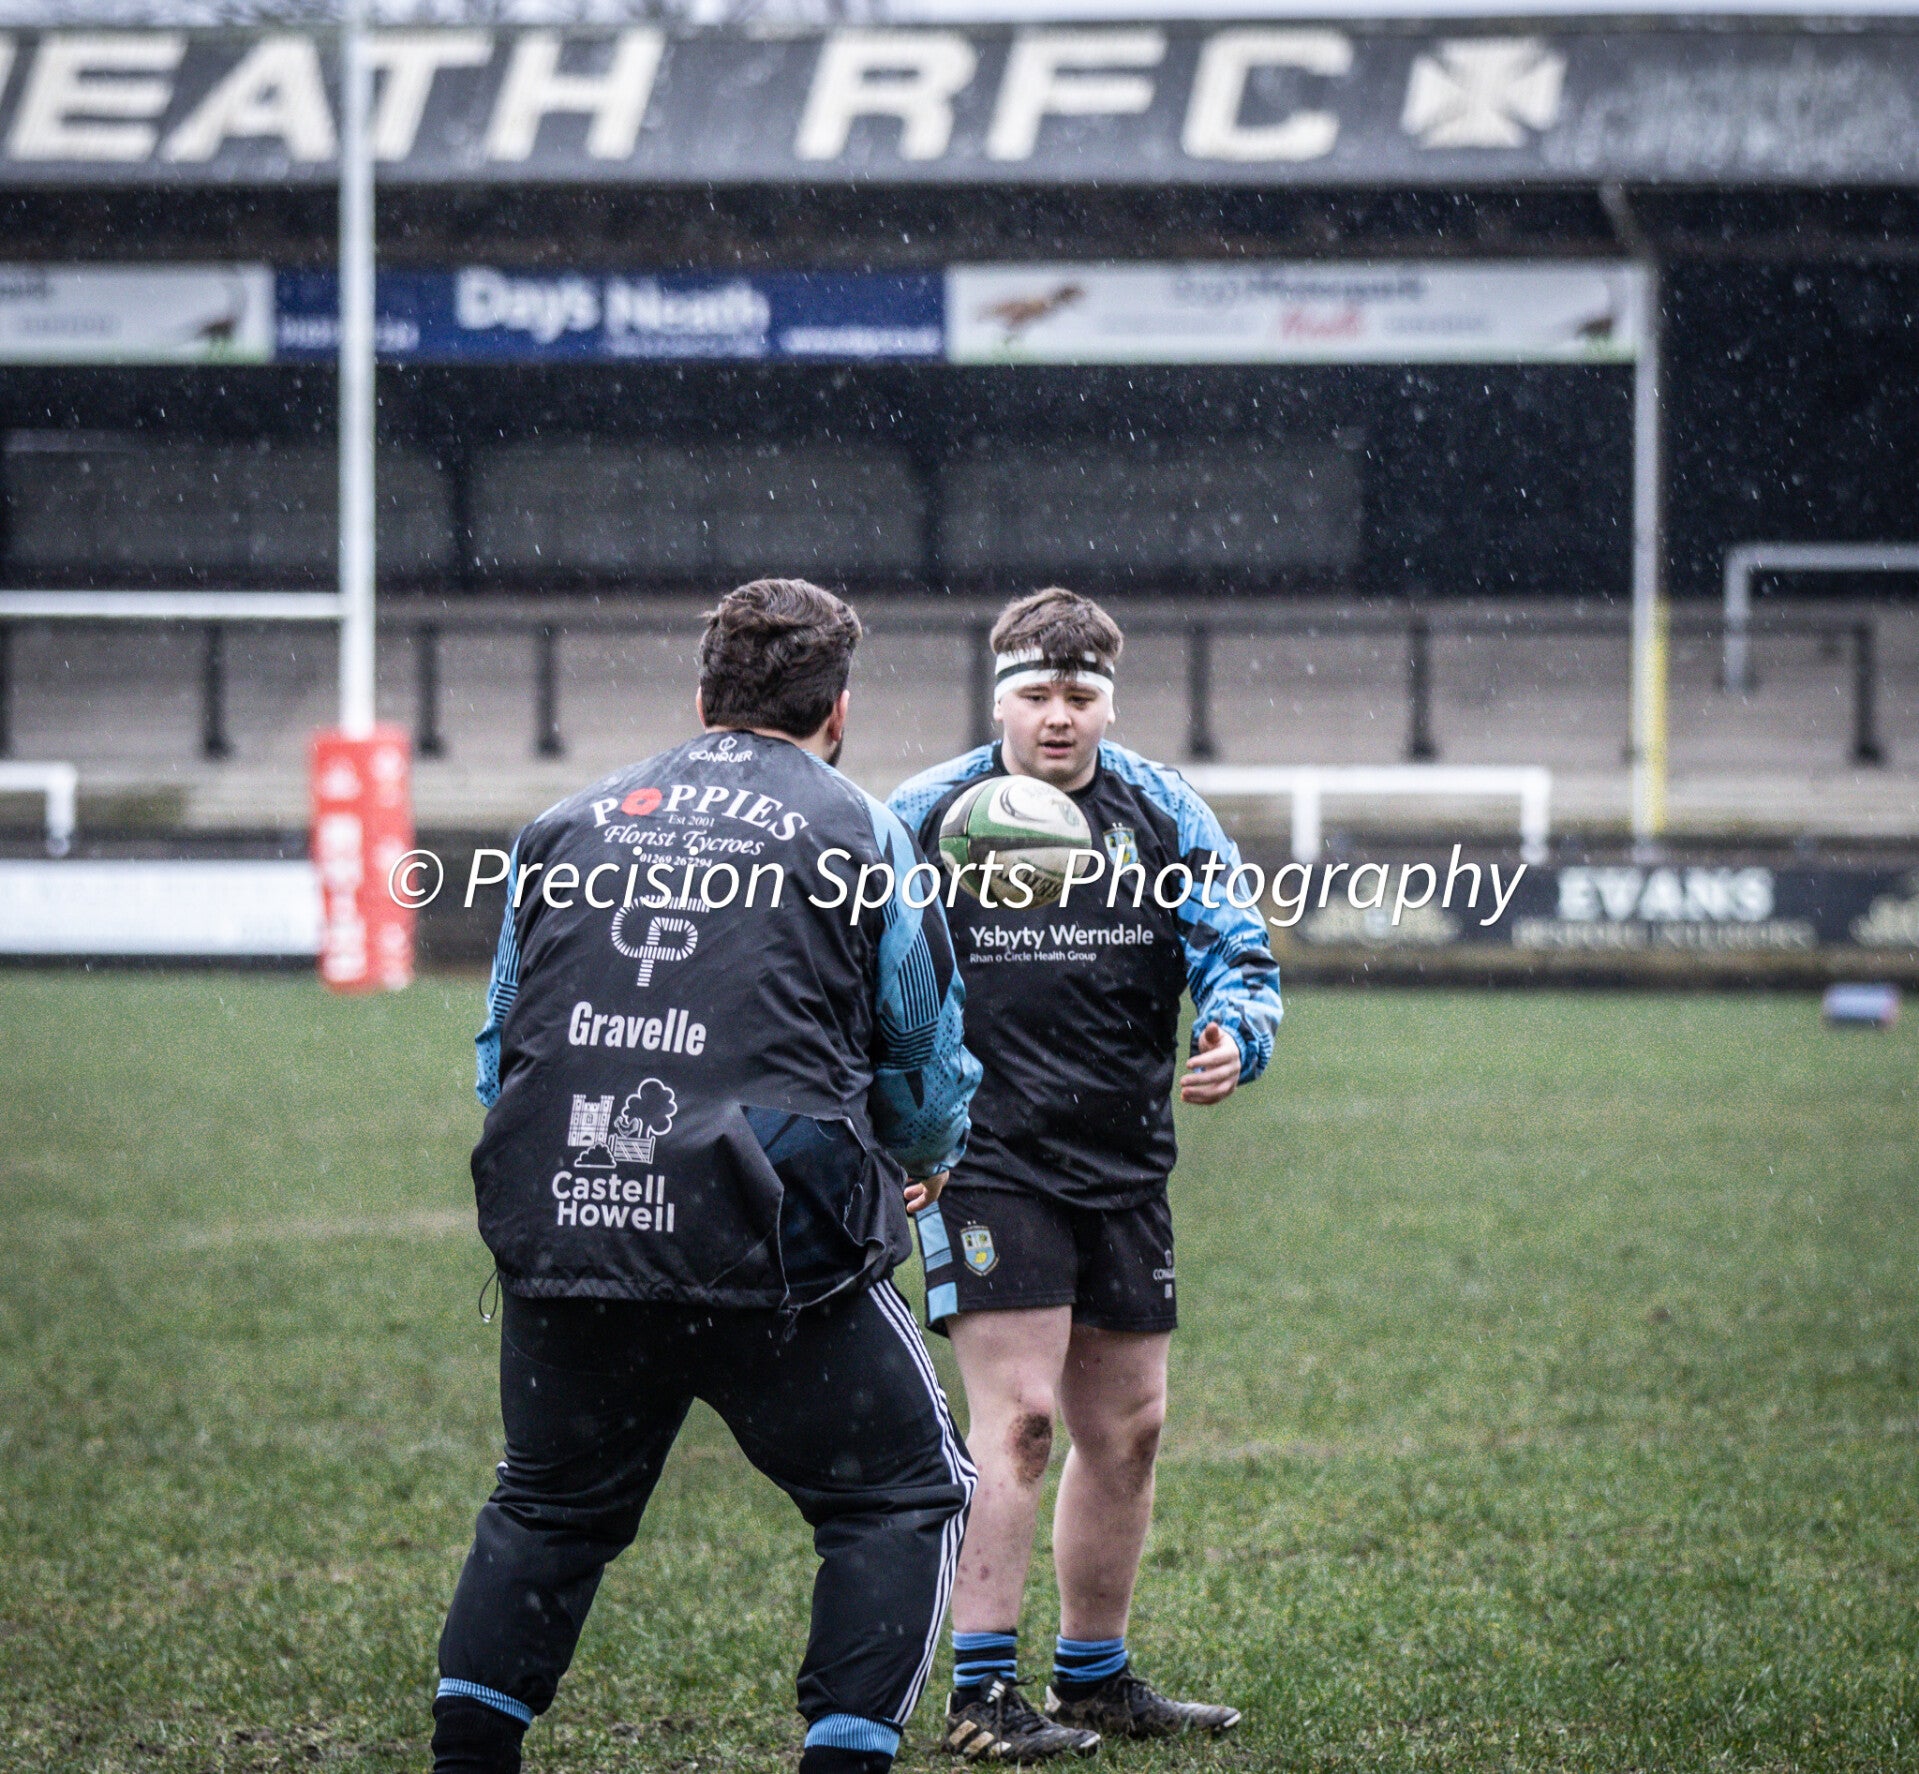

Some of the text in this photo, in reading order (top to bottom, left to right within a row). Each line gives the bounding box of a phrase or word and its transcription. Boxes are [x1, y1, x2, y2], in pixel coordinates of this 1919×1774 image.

[0, 29, 1354, 161] EATH RFC
[689, 749, 753, 763] CONQUER
[668, 814, 715, 828] Est 2001
[604, 823, 765, 856] Florist Tycroes
[1558, 866, 1776, 922] EVANS
[969, 922, 1154, 950] Ysbyty Werndale
[969, 952, 994, 963] Rhan
[1004, 950, 1032, 962] Circle
[1033, 950, 1066, 962] Health
[1067, 951, 1097, 963] Group
[567, 1001, 707, 1057] Gravelle
[551, 1171, 666, 1205] Castell
[557, 1200, 675, 1234] Howell
